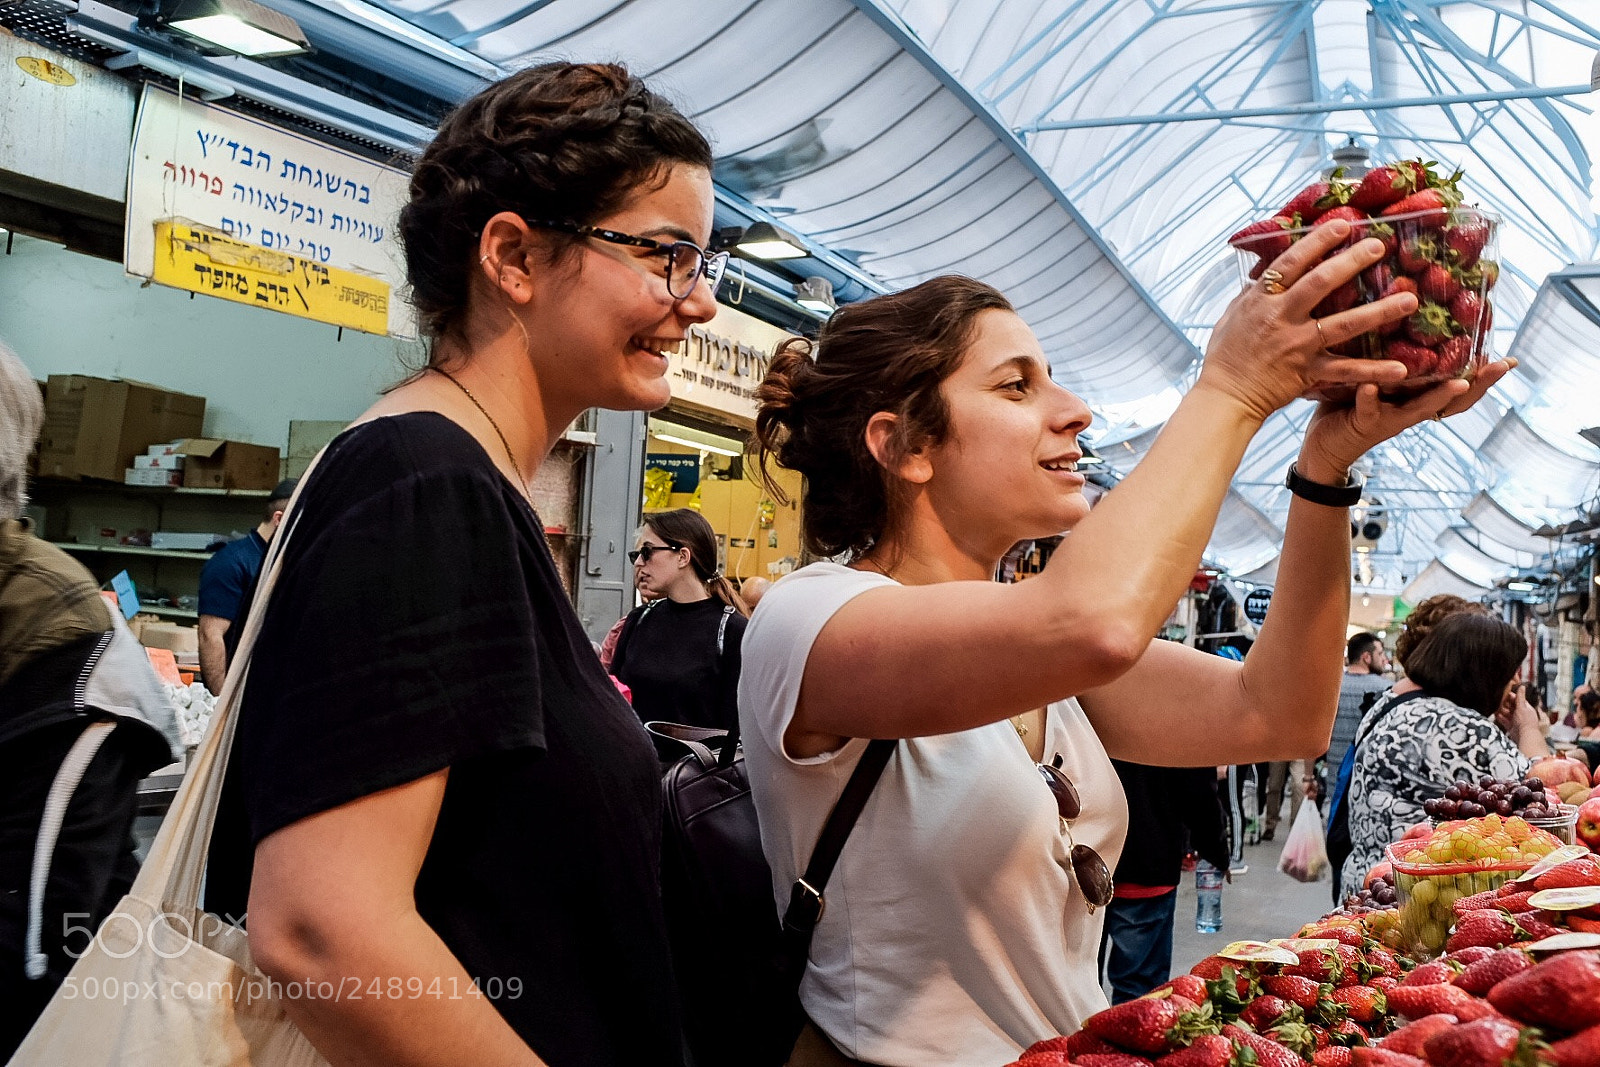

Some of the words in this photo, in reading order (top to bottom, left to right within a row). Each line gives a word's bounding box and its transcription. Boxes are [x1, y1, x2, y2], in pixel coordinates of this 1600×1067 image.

[163, 160, 224, 196] פרווה
[280, 159, 371, 205] בהשגחת
[232, 182, 324, 224] ובקלאווה
[221, 217, 253, 242] יום
[261, 228, 291, 254] יום
[330, 211, 385, 244] עוגיות
[299, 238, 332, 263] טרי
[255, 280, 290, 307] הרב
